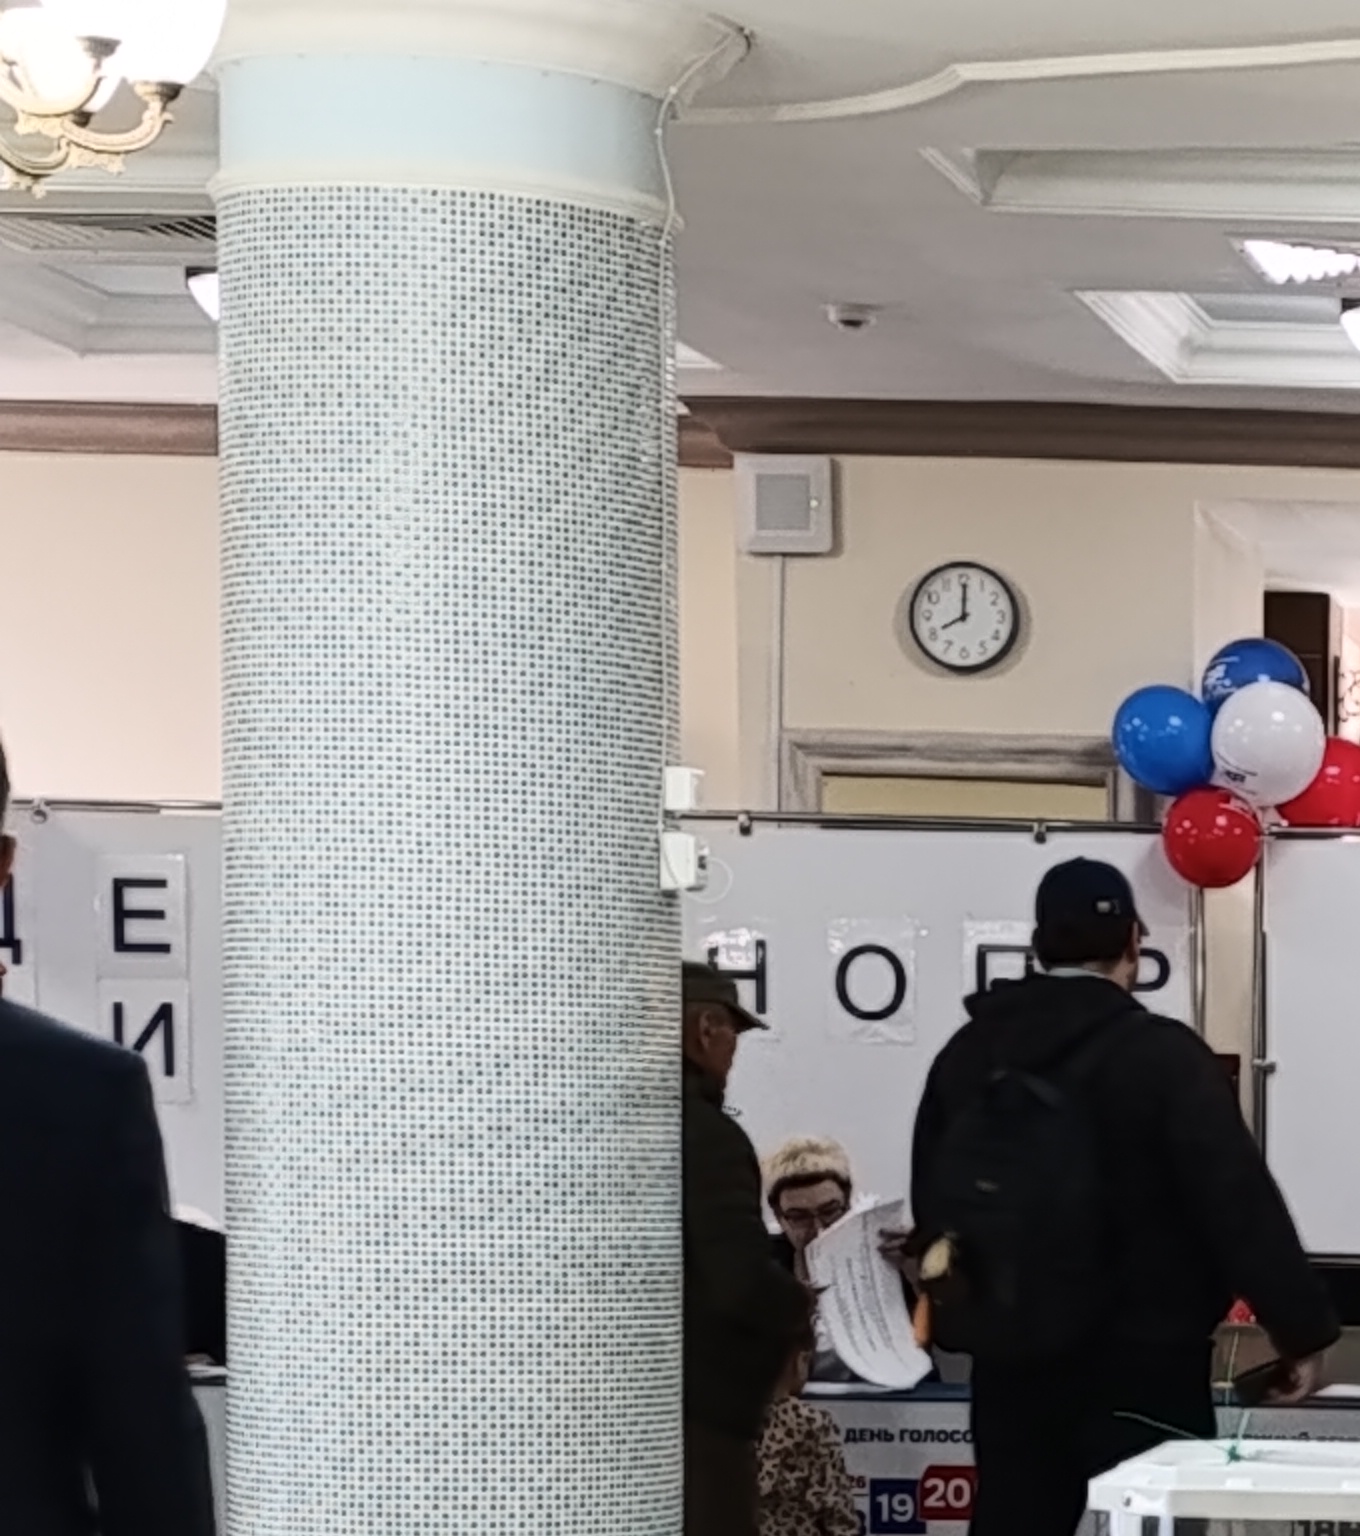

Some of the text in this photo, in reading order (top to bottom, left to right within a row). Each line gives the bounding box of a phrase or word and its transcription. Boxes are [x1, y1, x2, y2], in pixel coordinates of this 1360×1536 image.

[996, 608, 1006, 625] 3
[928, 626, 938, 641] 8
[943, 639, 954, 655] 7
[959, 645, 970, 660] 6
[113, 877, 171, 953] Е
[835, 943, 907, 1020] О
[113, 1001, 174, 1077] И
[844, 1427, 895, 1445] ДЕНЬ
[875, 1492, 916, 1524] 19
[922, 1477, 972, 1510] 20
